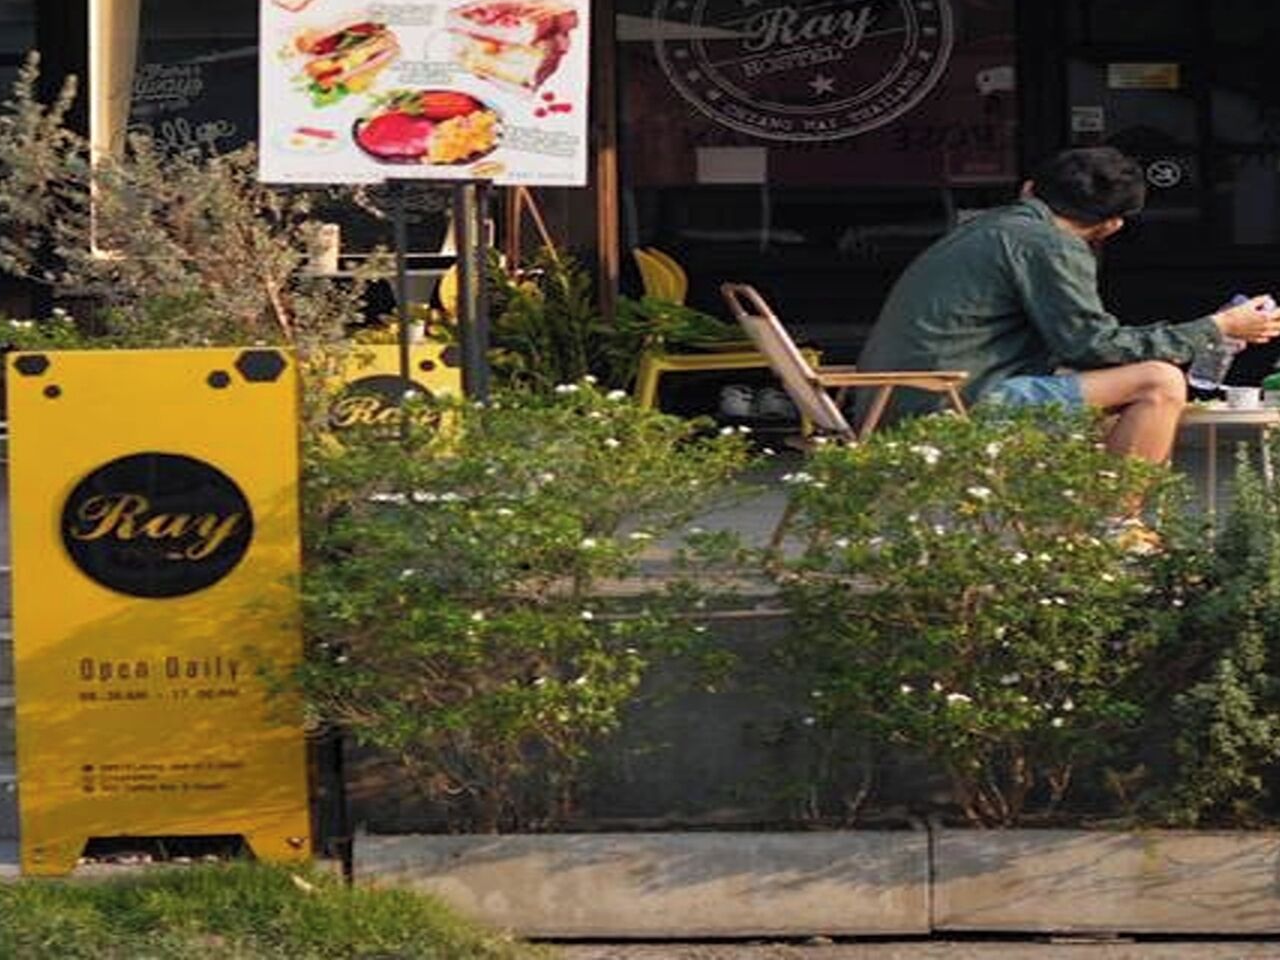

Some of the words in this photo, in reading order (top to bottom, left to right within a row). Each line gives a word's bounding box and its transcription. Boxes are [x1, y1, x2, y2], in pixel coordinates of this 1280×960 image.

[742, 5, 876, 50] Ray
[741, 47, 844, 78] HOSTEL
[70, 493, 243, 560] Ray
[79, 657, 150, 681] Open
[166, 656, 240, 682] Daily
